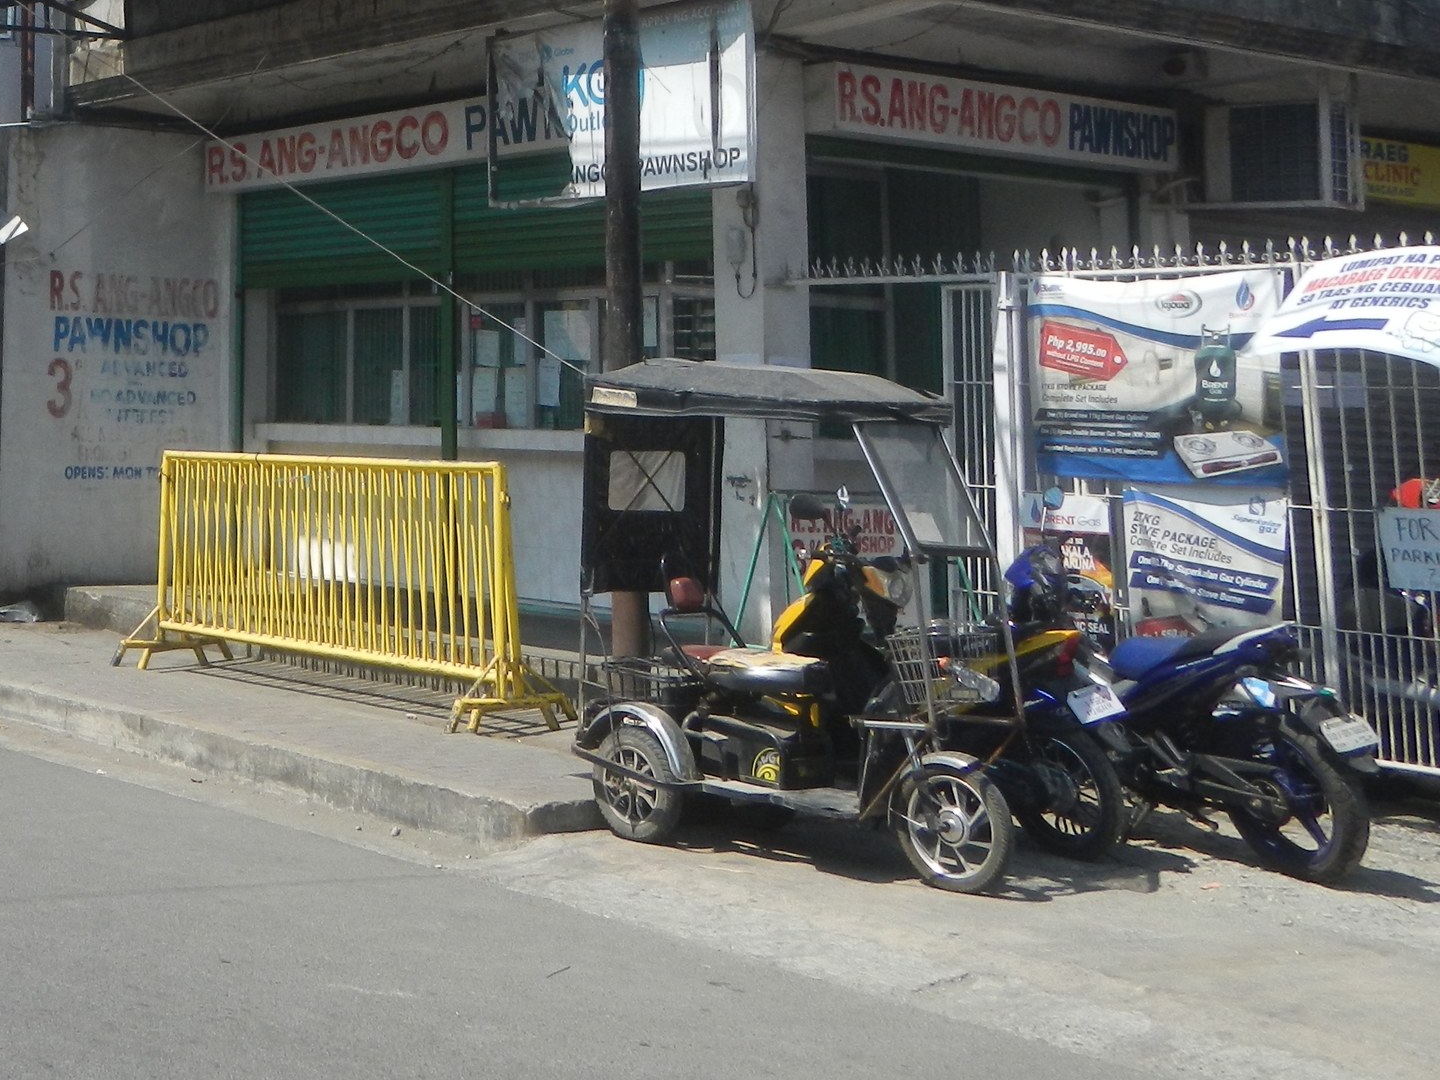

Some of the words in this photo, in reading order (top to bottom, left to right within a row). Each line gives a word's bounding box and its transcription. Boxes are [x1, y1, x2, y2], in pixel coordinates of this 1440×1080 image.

[1068, 103, 1176, 162] PAWNSHOP
[257, 110, 450, 179] ANG-ANGCO
[1340, 255, 1404, 272] LUMIPAT
[1406, 253, 1427, 264] NA
[1303, 268, 1388, 294] MACARAEG
[1297, 294, 1315, 306] SA
[1318, 286, 1354, 300] TAAS
[1354, 283, 1378, 294] NG
[1328, 299, 1349, 310] AT
[1350, 296, 1432, 309] GENERICS
[53, 316, 210, 357] PAWNSHOP
[1047, 335, 1065, 350] Php
[1065, 339, 1108, 358] 2,995.00
[1066, 353, 1080, 363] LPG
[1077, 383, 1107, 392] PACKAGE
[1042, 393, 1074, 403] Complete
[1075, 394, 1087, 403] Set
[1088, 395, 1118, 404] Includes
[112, 466, 142, 480] MON
[1077, 515, 1103, 527] Gas
[1394, 517, 1440, 542] FOR
[1162, 530, 1217, 550] PACKAGE
[1169, 543, 1186, 556] Set
[1189, 546, 1232, 564] Includes
[1235, 575, 1269, 590] Cylinder
[1087, 621, 1110, 635] SEAL
